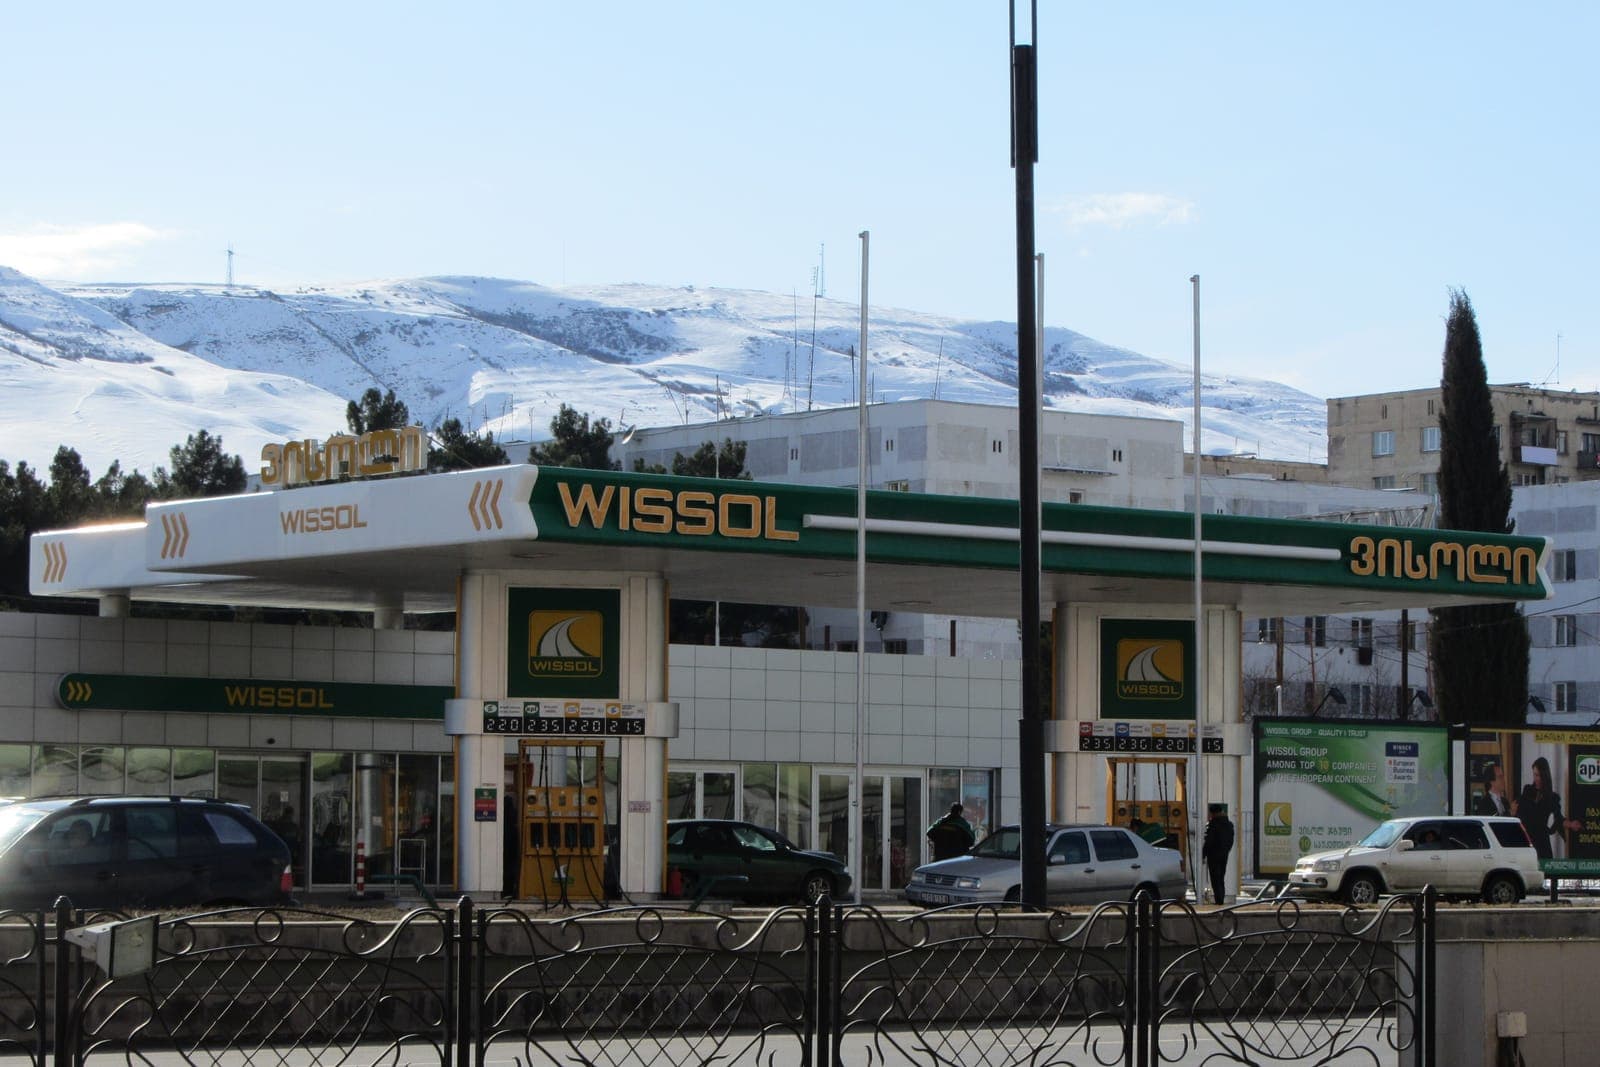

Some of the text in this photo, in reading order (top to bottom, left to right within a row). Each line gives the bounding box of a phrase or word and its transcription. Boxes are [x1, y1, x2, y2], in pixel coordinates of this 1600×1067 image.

[557, 482, 799, 541] WISSOL
[280, 504, 367, 534] WISSOL
[1350, 536, 1537, 585] ვისოლი
[532, 660, 598, 672] WISSOL
[1121, 684, 1180, 695] WISSOL
[225, 685, 334, 709] WISSOL
[486, 719, 519, 731] 220
[527, 719, 560, 732] 235
[568, 719, 601, 732] 220
[609, 720, 642, 733] 215
[1082, 737, 1111, 749] 235
[1155, 739, 1185, 751] 220
[1266, 746, 1328, 757] WISSOL GROUP
[1266, 759, 1377, 771] AMONG TOP 10 COMPANIES
[1580, 760, 1600, 780] api
[1335, 774, 1376, 784] CONTINENT
